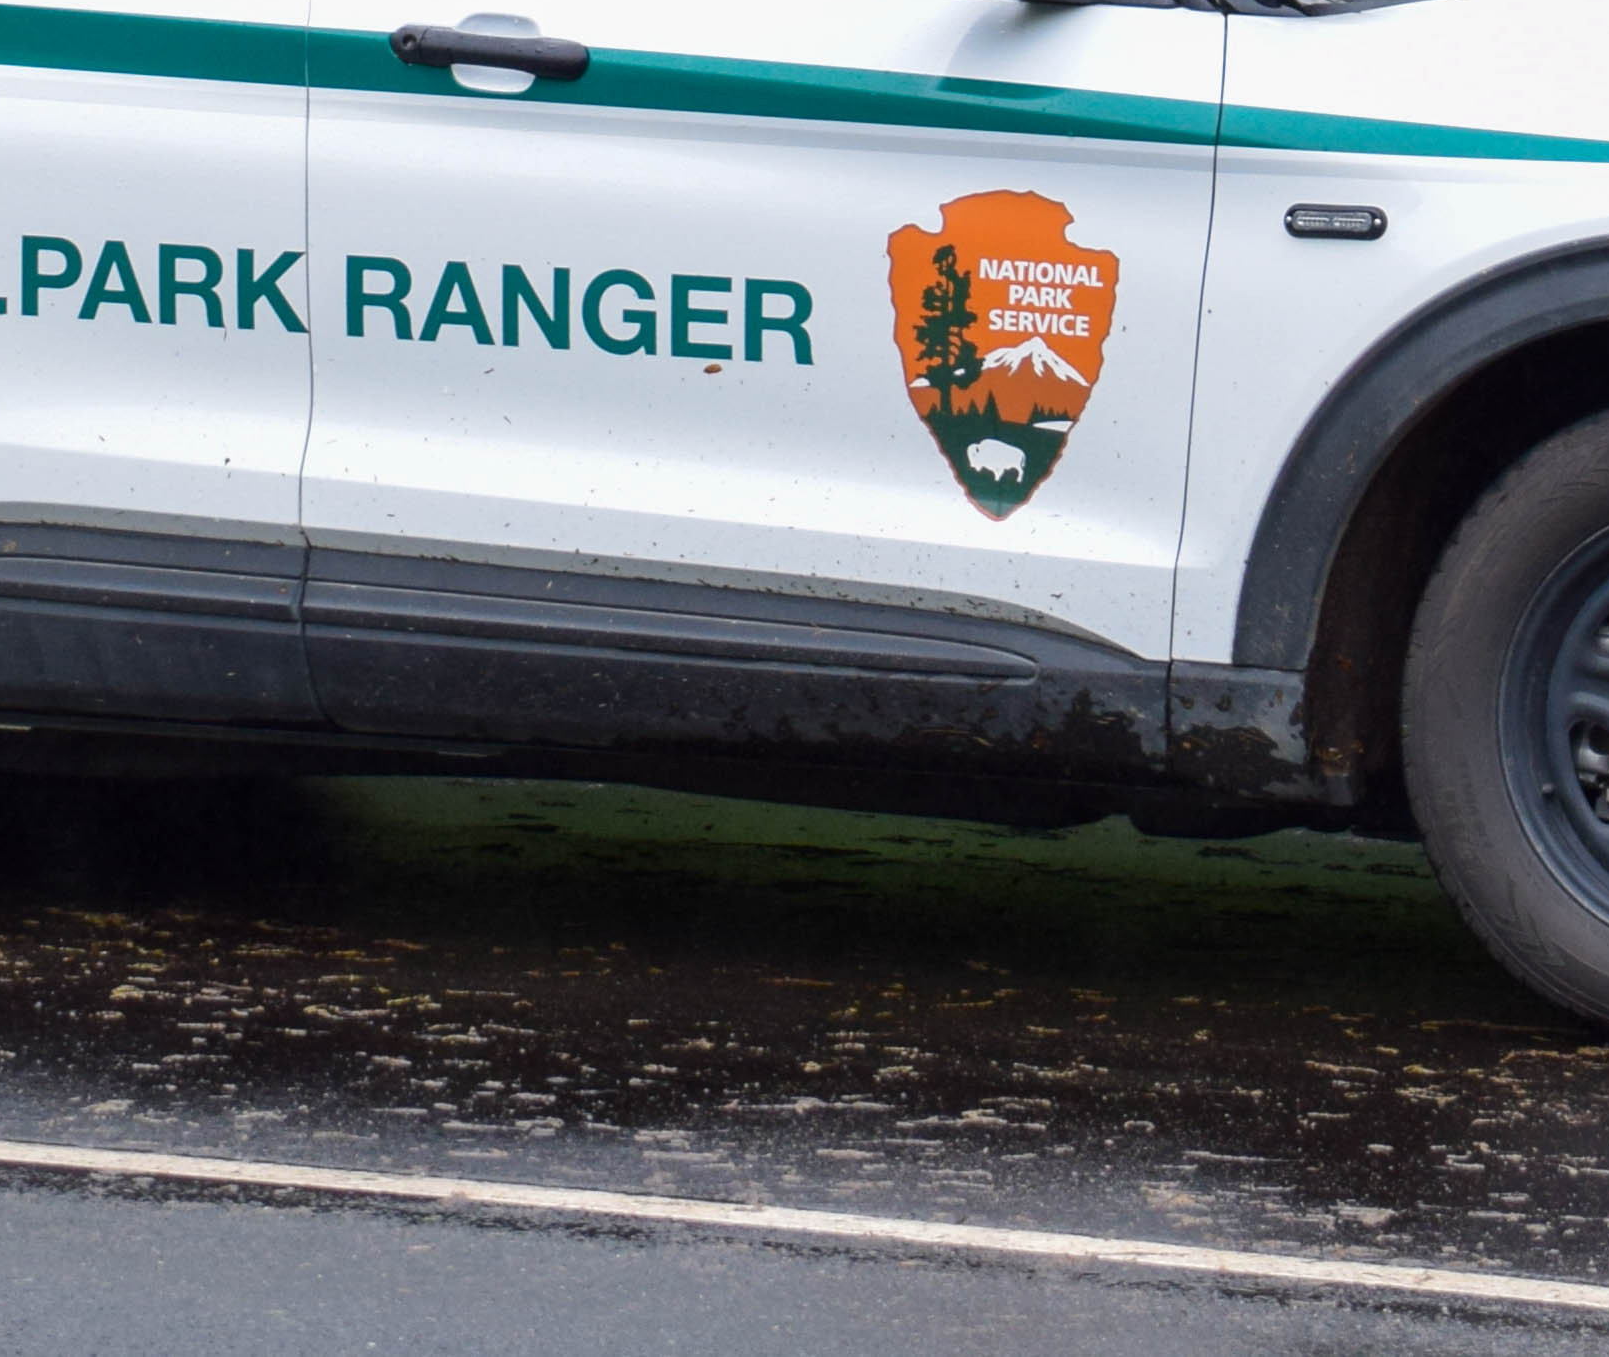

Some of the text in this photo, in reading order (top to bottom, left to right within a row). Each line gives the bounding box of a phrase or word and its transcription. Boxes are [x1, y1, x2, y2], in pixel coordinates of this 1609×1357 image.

[978, 258, 1104, 287] NATIONAL
[345, 255, 815, 366] RANGER
[1008, 284, 1073, 310] PARK
[988, 309, 1090, 337] SERVICE
